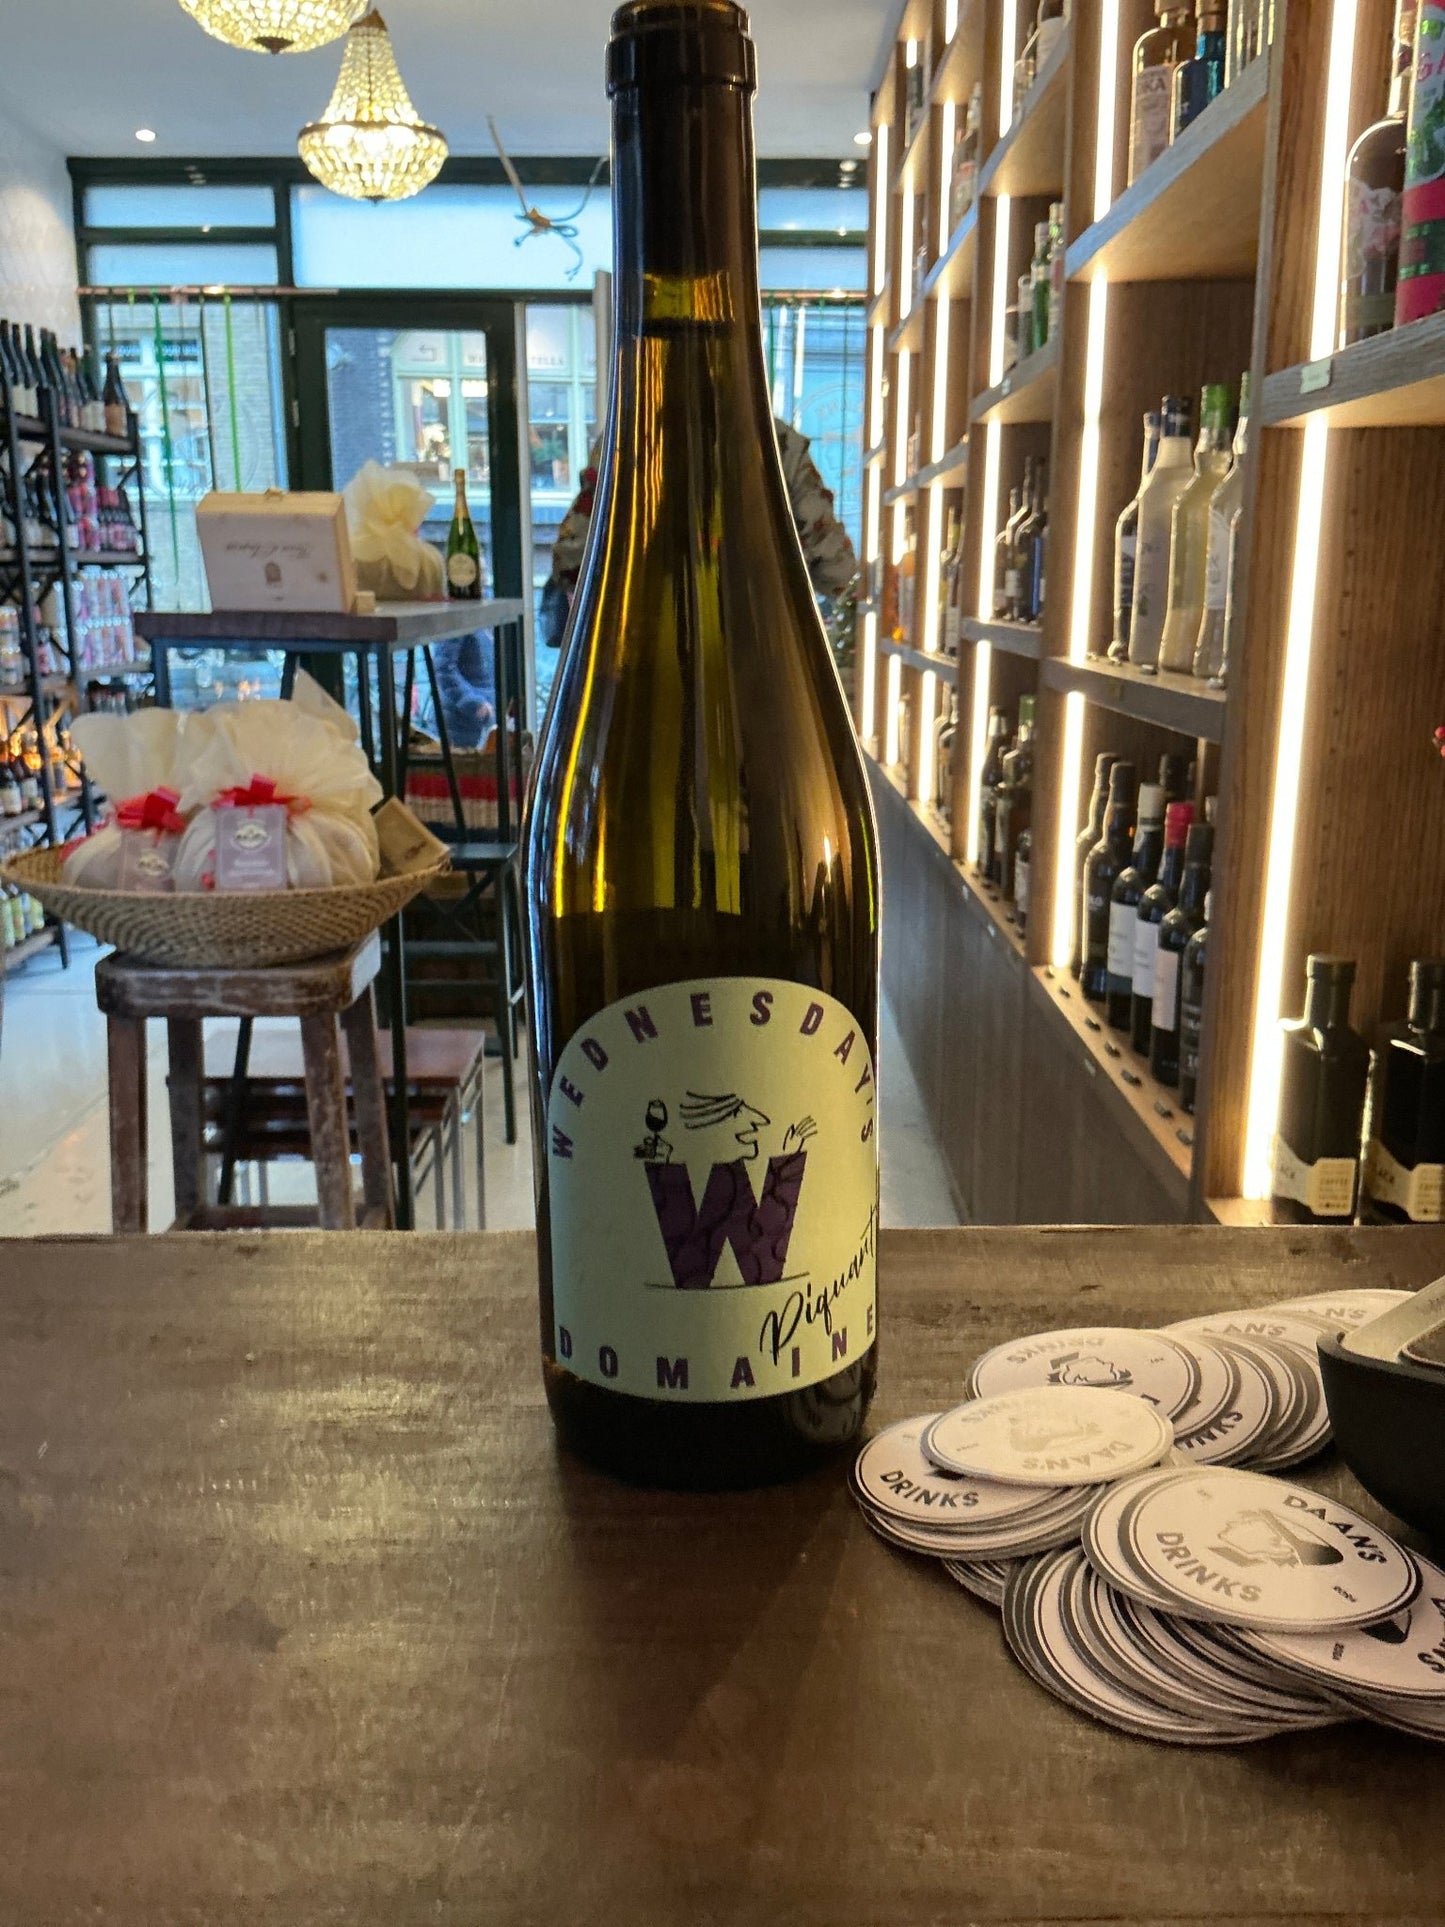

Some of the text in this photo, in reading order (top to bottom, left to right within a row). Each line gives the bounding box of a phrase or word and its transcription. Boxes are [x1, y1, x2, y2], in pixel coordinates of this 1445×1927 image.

[552, 991, 874, 1160] WEDNESDAY'S
[557, 1303, 874, 1391] DOMAINE
[880, 1469, 980, 1509] DRINKS
[1155, 1530, 1264, 1603] DRINKS
[1282, 1494, 1388, 1566] DAAN'S
